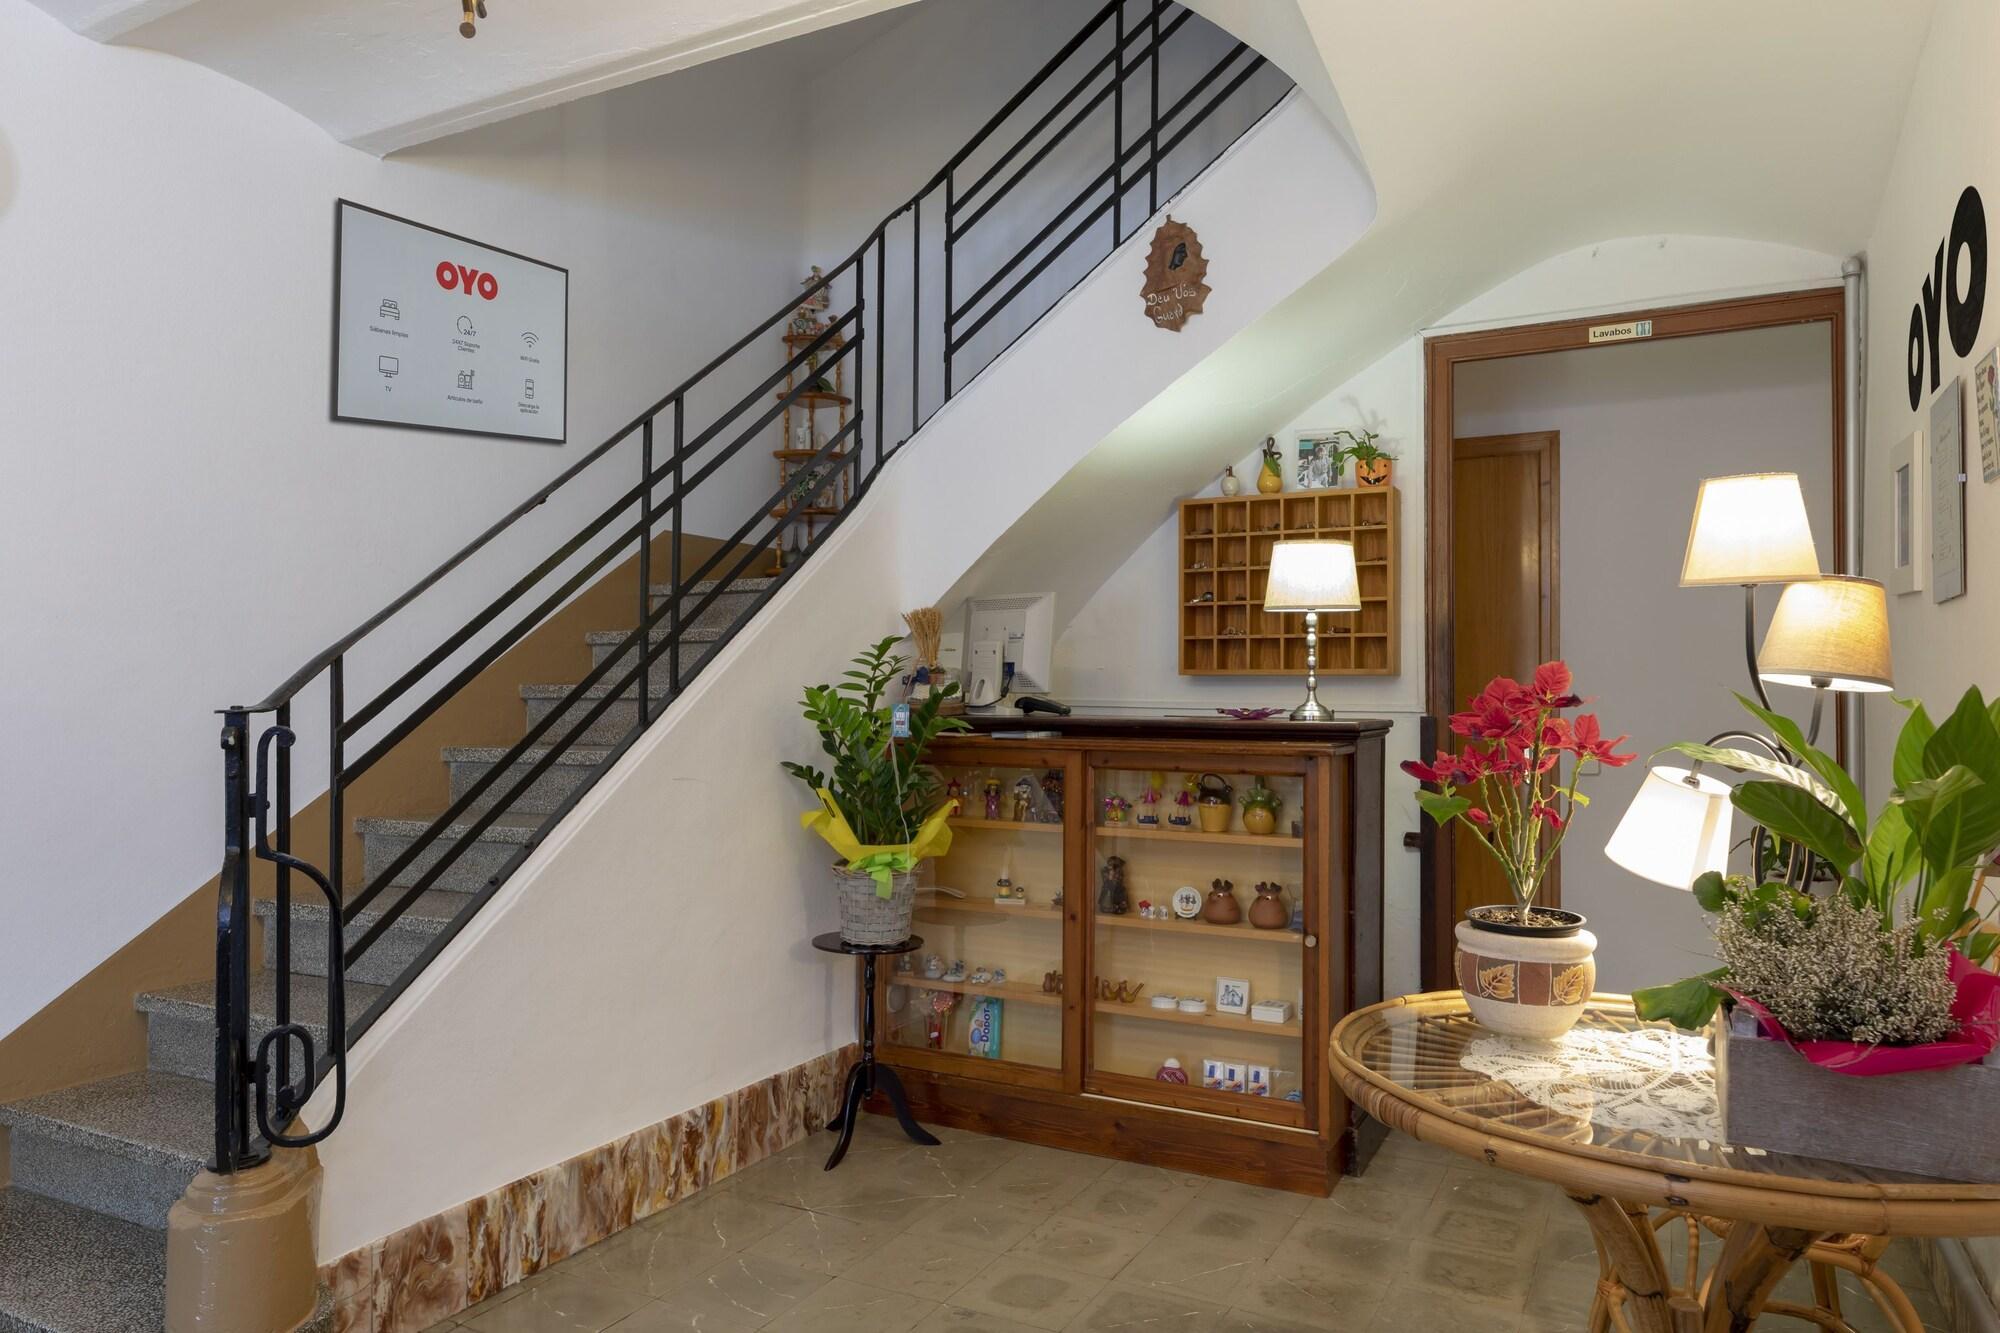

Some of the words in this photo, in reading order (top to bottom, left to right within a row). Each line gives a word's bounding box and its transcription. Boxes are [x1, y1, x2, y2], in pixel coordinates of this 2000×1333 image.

[436, 261, 499, 301] OYO
[1908, 185, 1988, 413] OYO
[463, 328, 477, 337] 24/7
[1593, 327, 1632, 338] Lavabos
[385, 385, 392, 393] TV
[980, 1007, 991, 1043] DODOT
